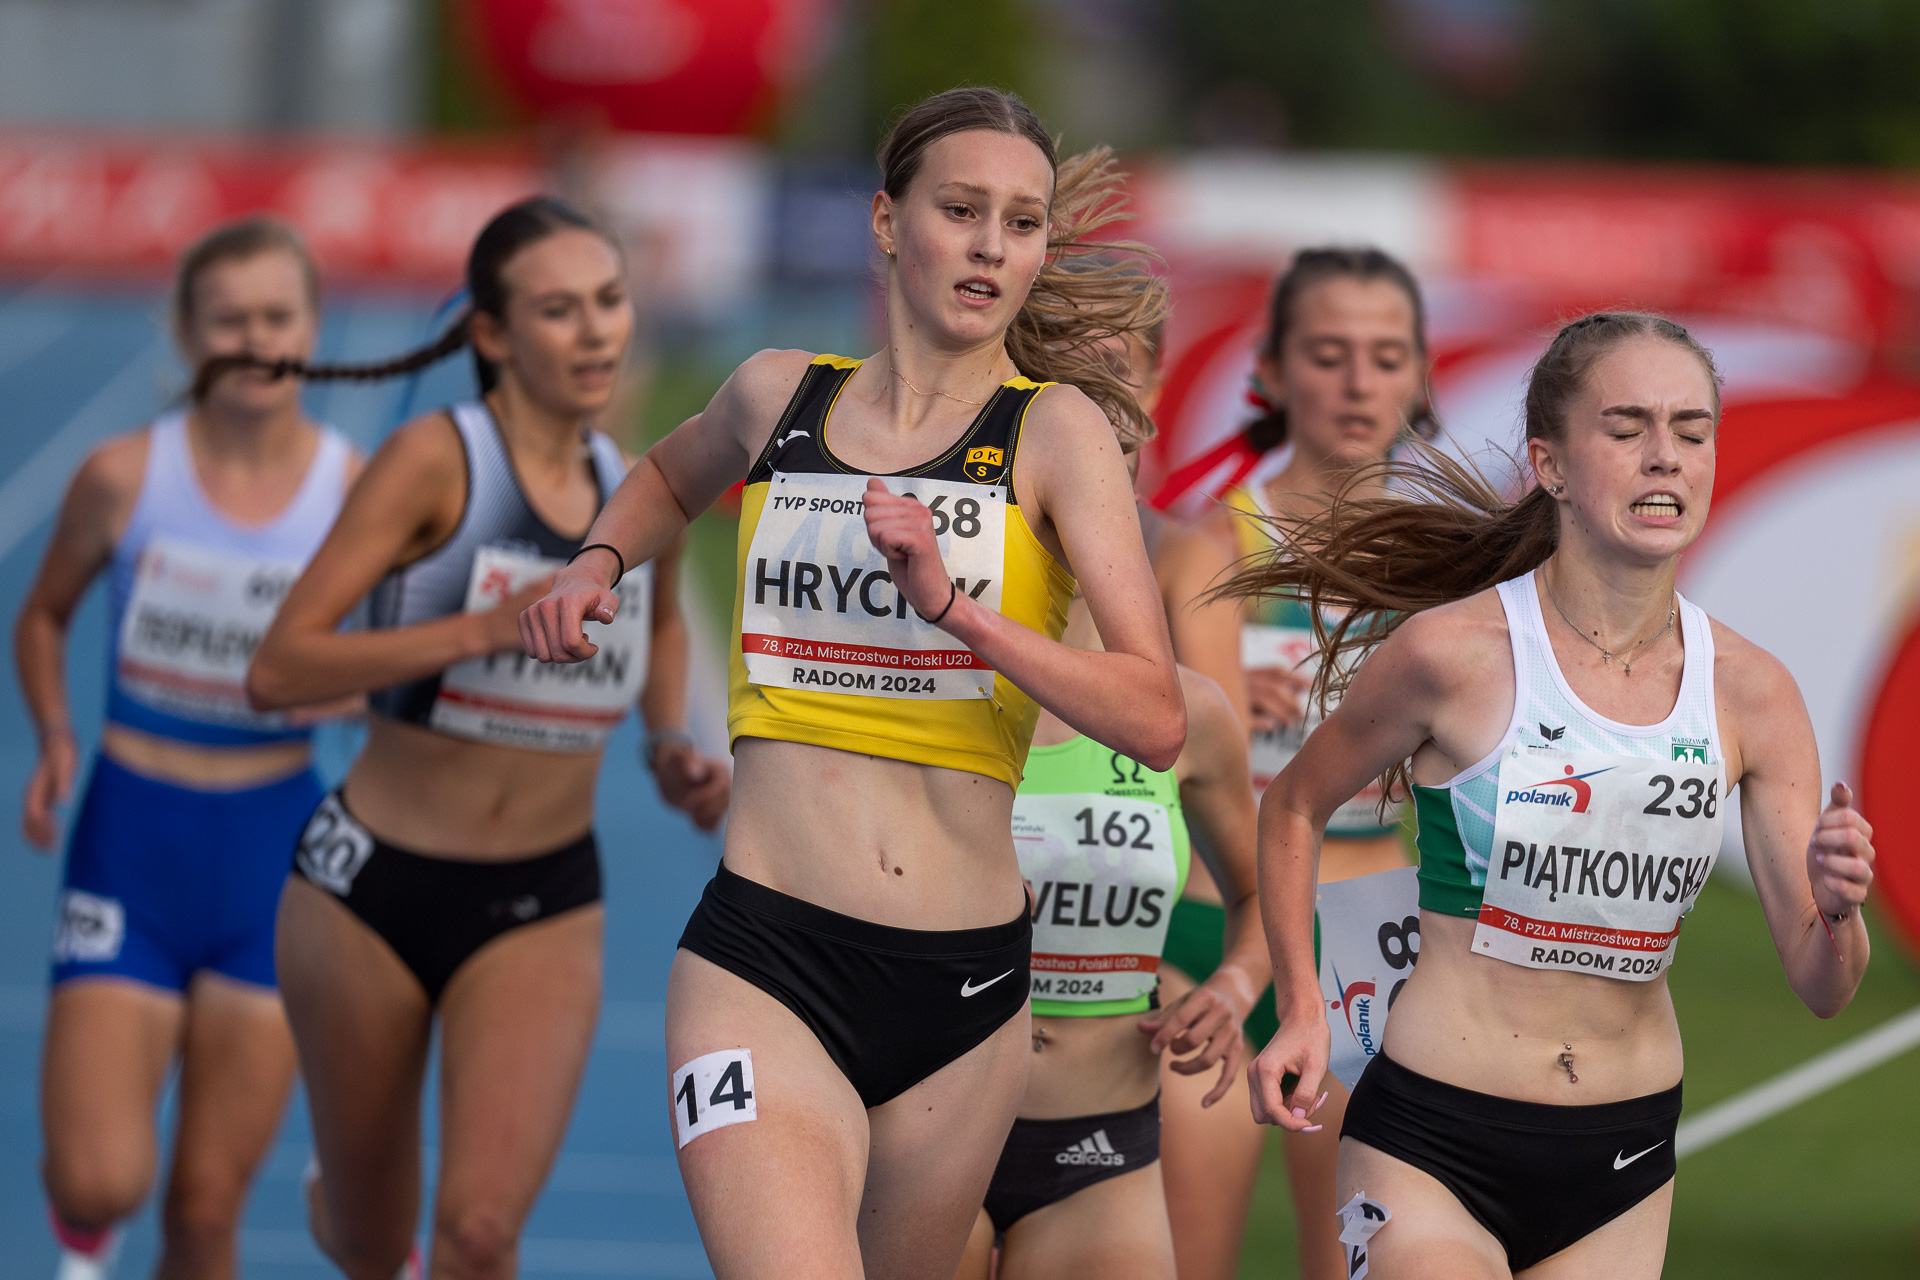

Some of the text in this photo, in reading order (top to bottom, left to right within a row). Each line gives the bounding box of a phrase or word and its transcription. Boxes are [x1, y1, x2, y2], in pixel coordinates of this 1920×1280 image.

[773, 496, 864, 515] TVP SPORT
[900, 492, 982, 539] 68
[754, 557, 992, 621] HRYCIK
[761, 638, 973, 667] 78. PZLA Mistrzostwa Polski U20
[792, 666, 936, 694] RADOM 2024
[1642, 774, 1719, 819] 238
[1074, 807, 1155, 851] 162
[1500, 840, 1711, 904] PIĄTKOWSKA
[1502, 914, 1523, 932] 78.
[1525, 922, 1558, 939] PZLA
[1560, 928, 1642, 947] Mistrzostwa
[1078, 957, 1114, 971] Polski
[1530, 946, 1663, 975] RADOM 2024
[1056, 978, 1105, 995] 2024
[676, 1060, 753, 1128] 14
[1055, 1151, 1126, 1167] adidas
